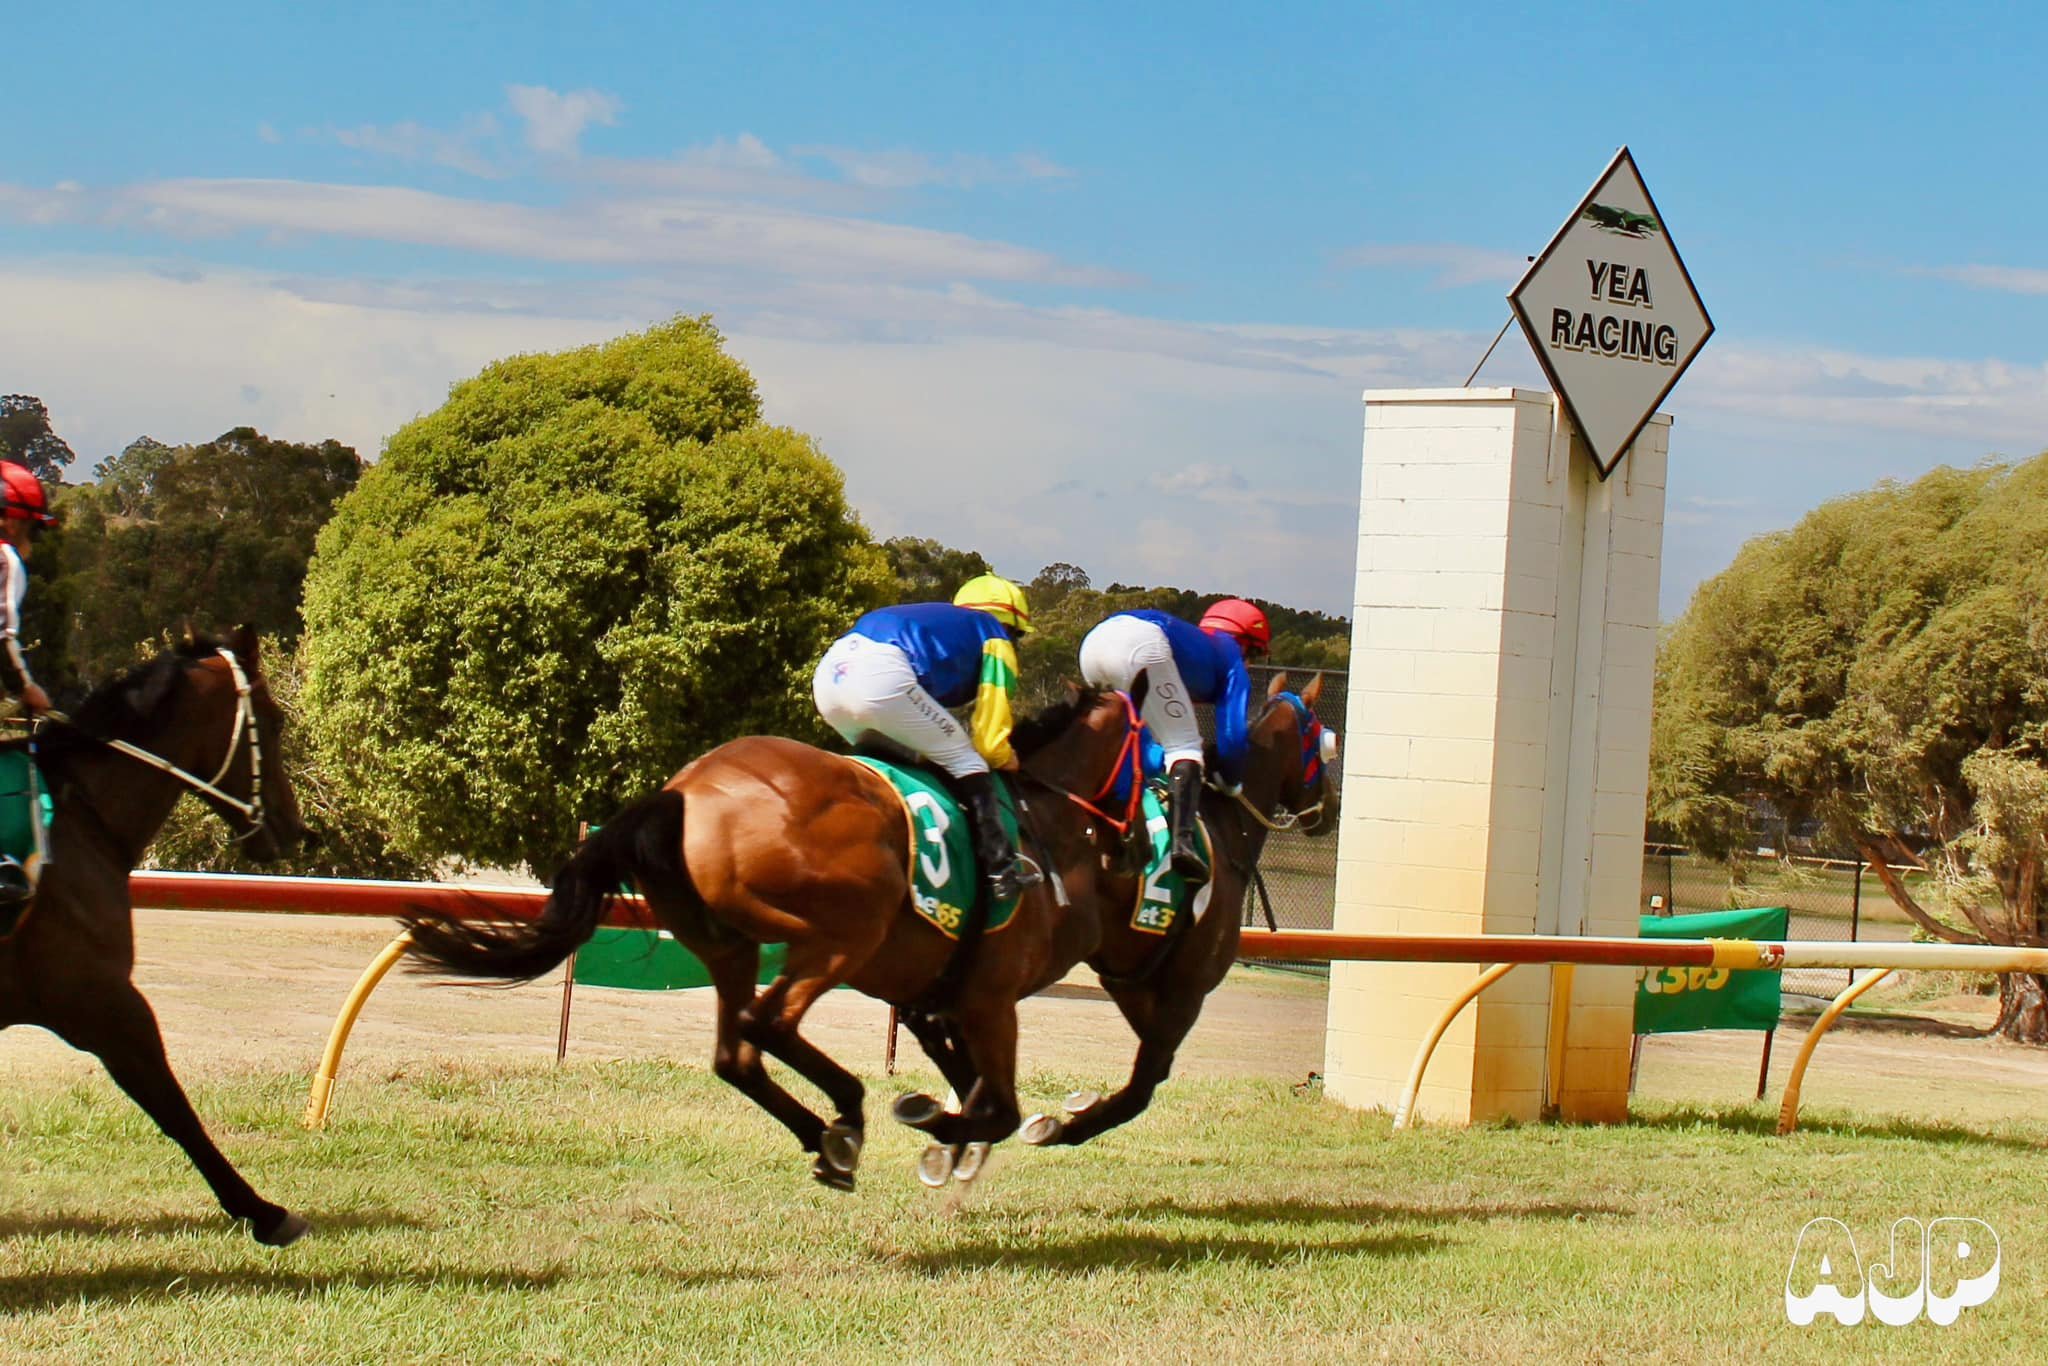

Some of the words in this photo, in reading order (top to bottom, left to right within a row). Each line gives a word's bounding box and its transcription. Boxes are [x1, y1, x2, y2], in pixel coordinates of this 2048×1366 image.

[1586, 259, 1652, 306] YEA
[1550, 308, 1677, 363] RACING
[1155, 682, 1188, 719] SG
[906, 791, 950, 889] 3
